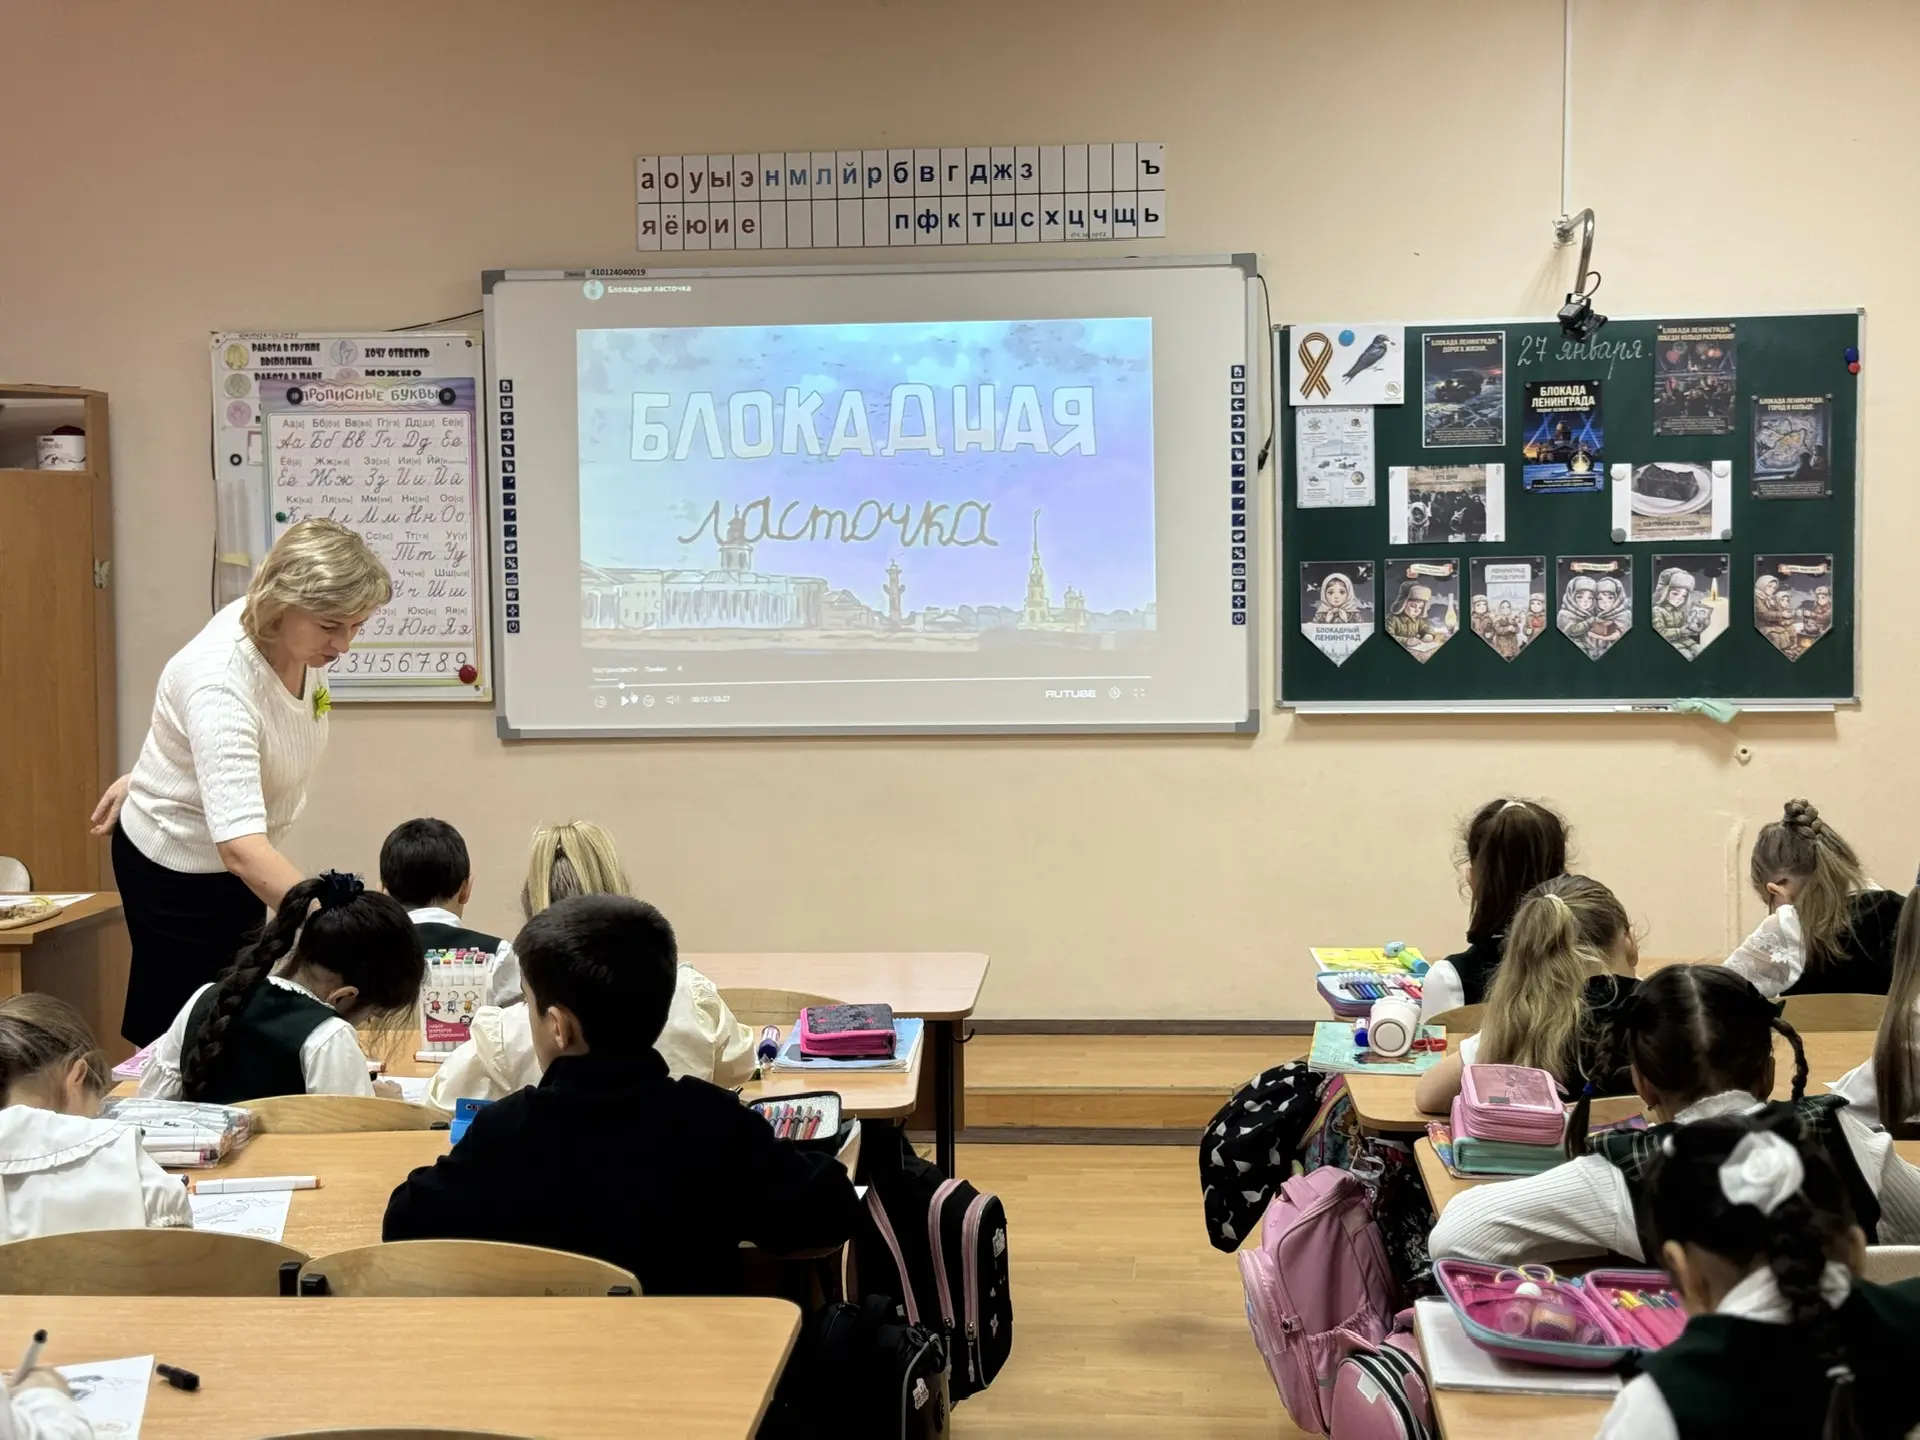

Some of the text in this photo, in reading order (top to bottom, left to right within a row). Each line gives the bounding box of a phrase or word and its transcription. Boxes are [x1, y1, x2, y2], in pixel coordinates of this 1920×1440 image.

[590, 268, 646, 276] 410124040019
[608, 286, 652, 294] Блокадная
[252, 343, 281, 352] РАБОТА
[290, 343, 320, 351] ГРУППЕ
[1517, 336, 1548, 366] 27
[365, 348, 430, 358] ХОЧУ ОТВЕТИТЬ
[260, 357, 312, 366] ВЫПОЛНЕНА
[391, 388, 440, 400] БУКВЫ
[1540, 385, 1586, 396] БЛОКАДА
[1531, 396, 1596, 407] ЛЕНИНГРАДА
[630, 383, 1097, 461] БЛОКАДНАЯ
[677, 496, 999, 546] ласточка
[1045, 690, 1096, 698] RUTUBE
